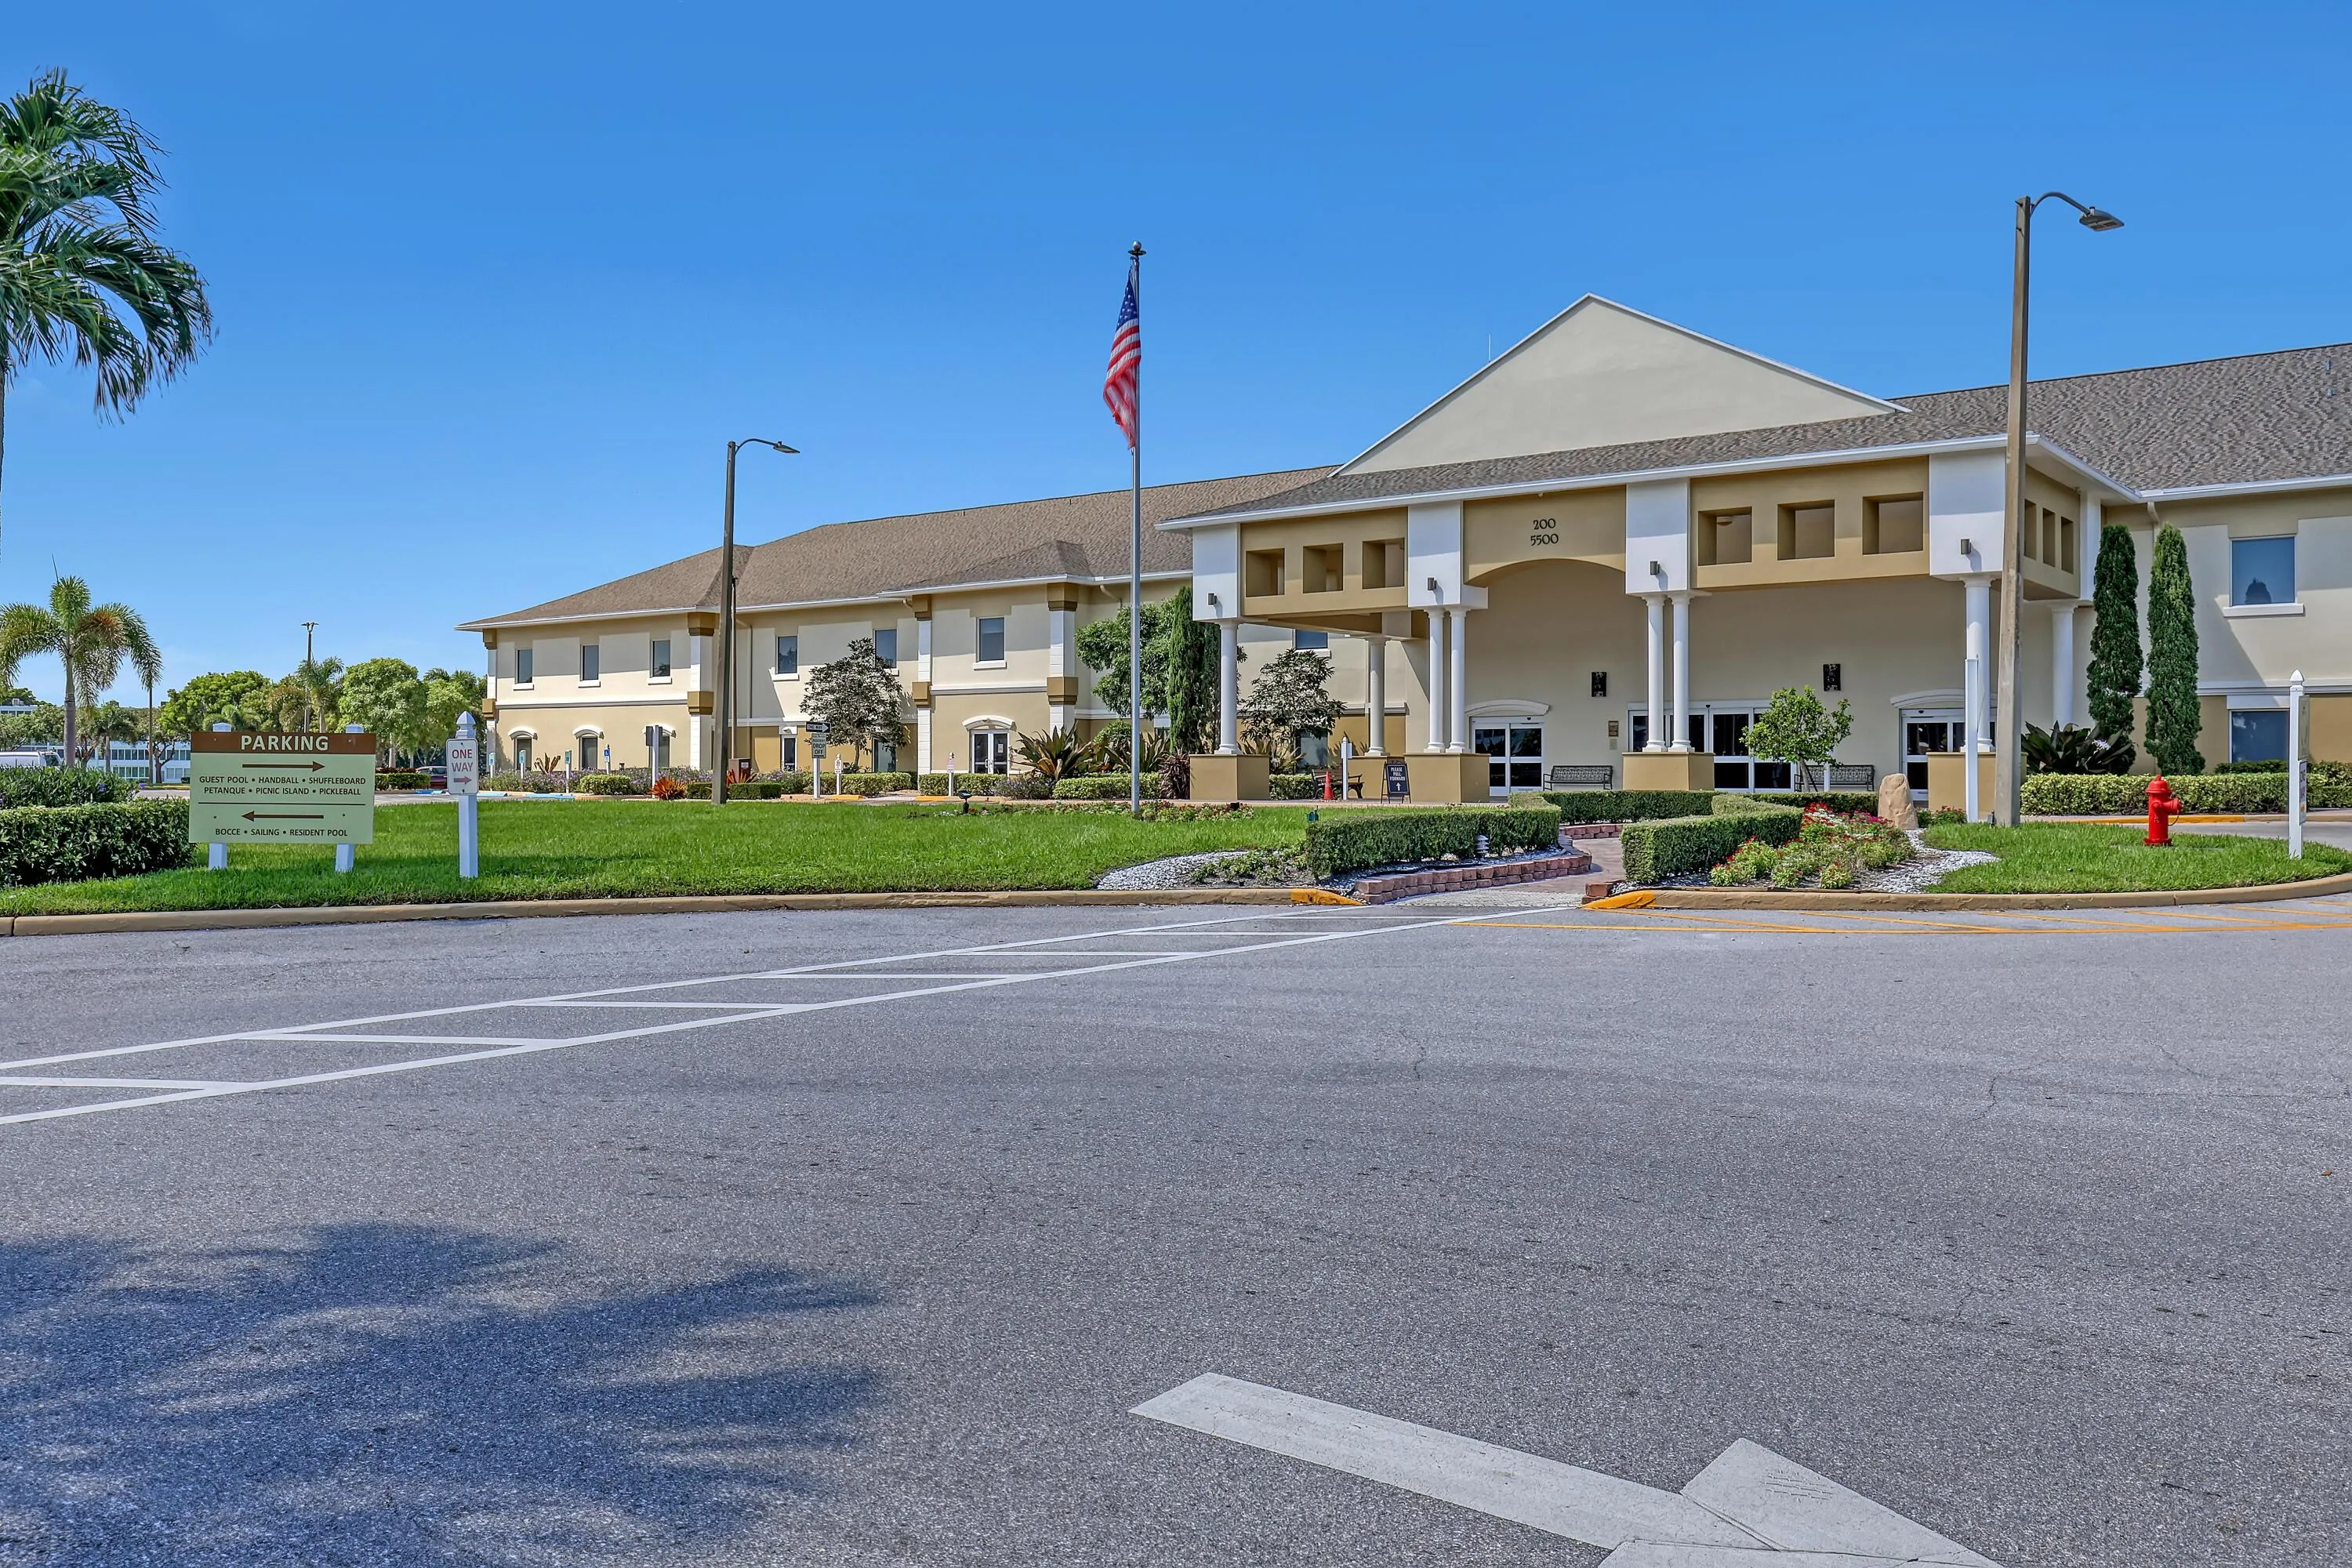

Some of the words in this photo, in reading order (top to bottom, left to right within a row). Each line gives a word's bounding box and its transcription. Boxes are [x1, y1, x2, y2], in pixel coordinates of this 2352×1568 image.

[1533, 518, 1556, 530] 200
[1530, 533, 1559, 546] 5500
[241, 735, 328, 751] PARKING
[452, 750, 473, 759] ONE
[452, 763, 474, 772] WAY
